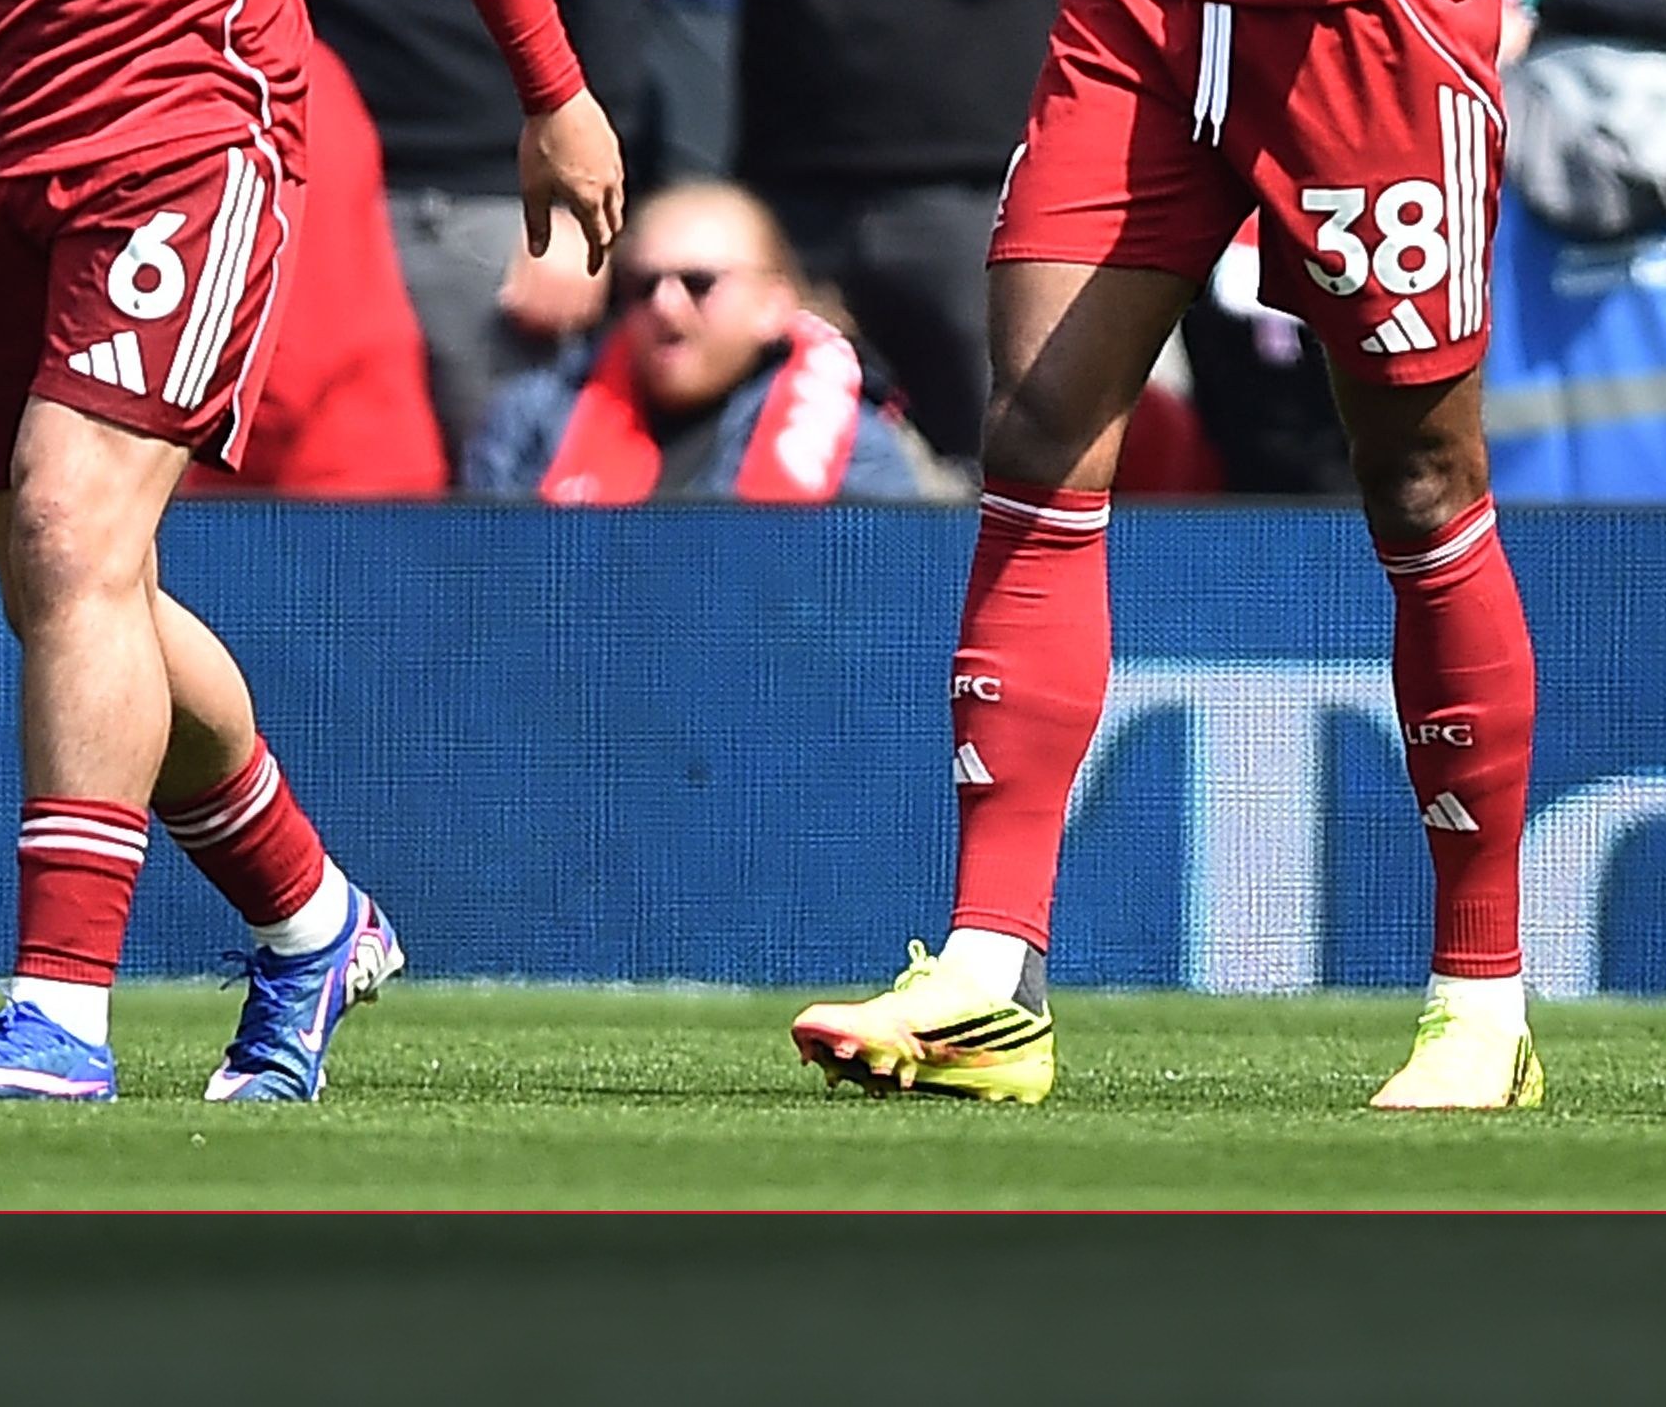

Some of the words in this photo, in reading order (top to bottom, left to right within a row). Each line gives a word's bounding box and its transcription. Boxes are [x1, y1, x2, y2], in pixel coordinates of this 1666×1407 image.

[107, 211, 187, 319] 6
[1302, 179, 1448, 295] 38
[952, 674, 1001, 701] FC
[1405, 722, 1473, 746] LFC
